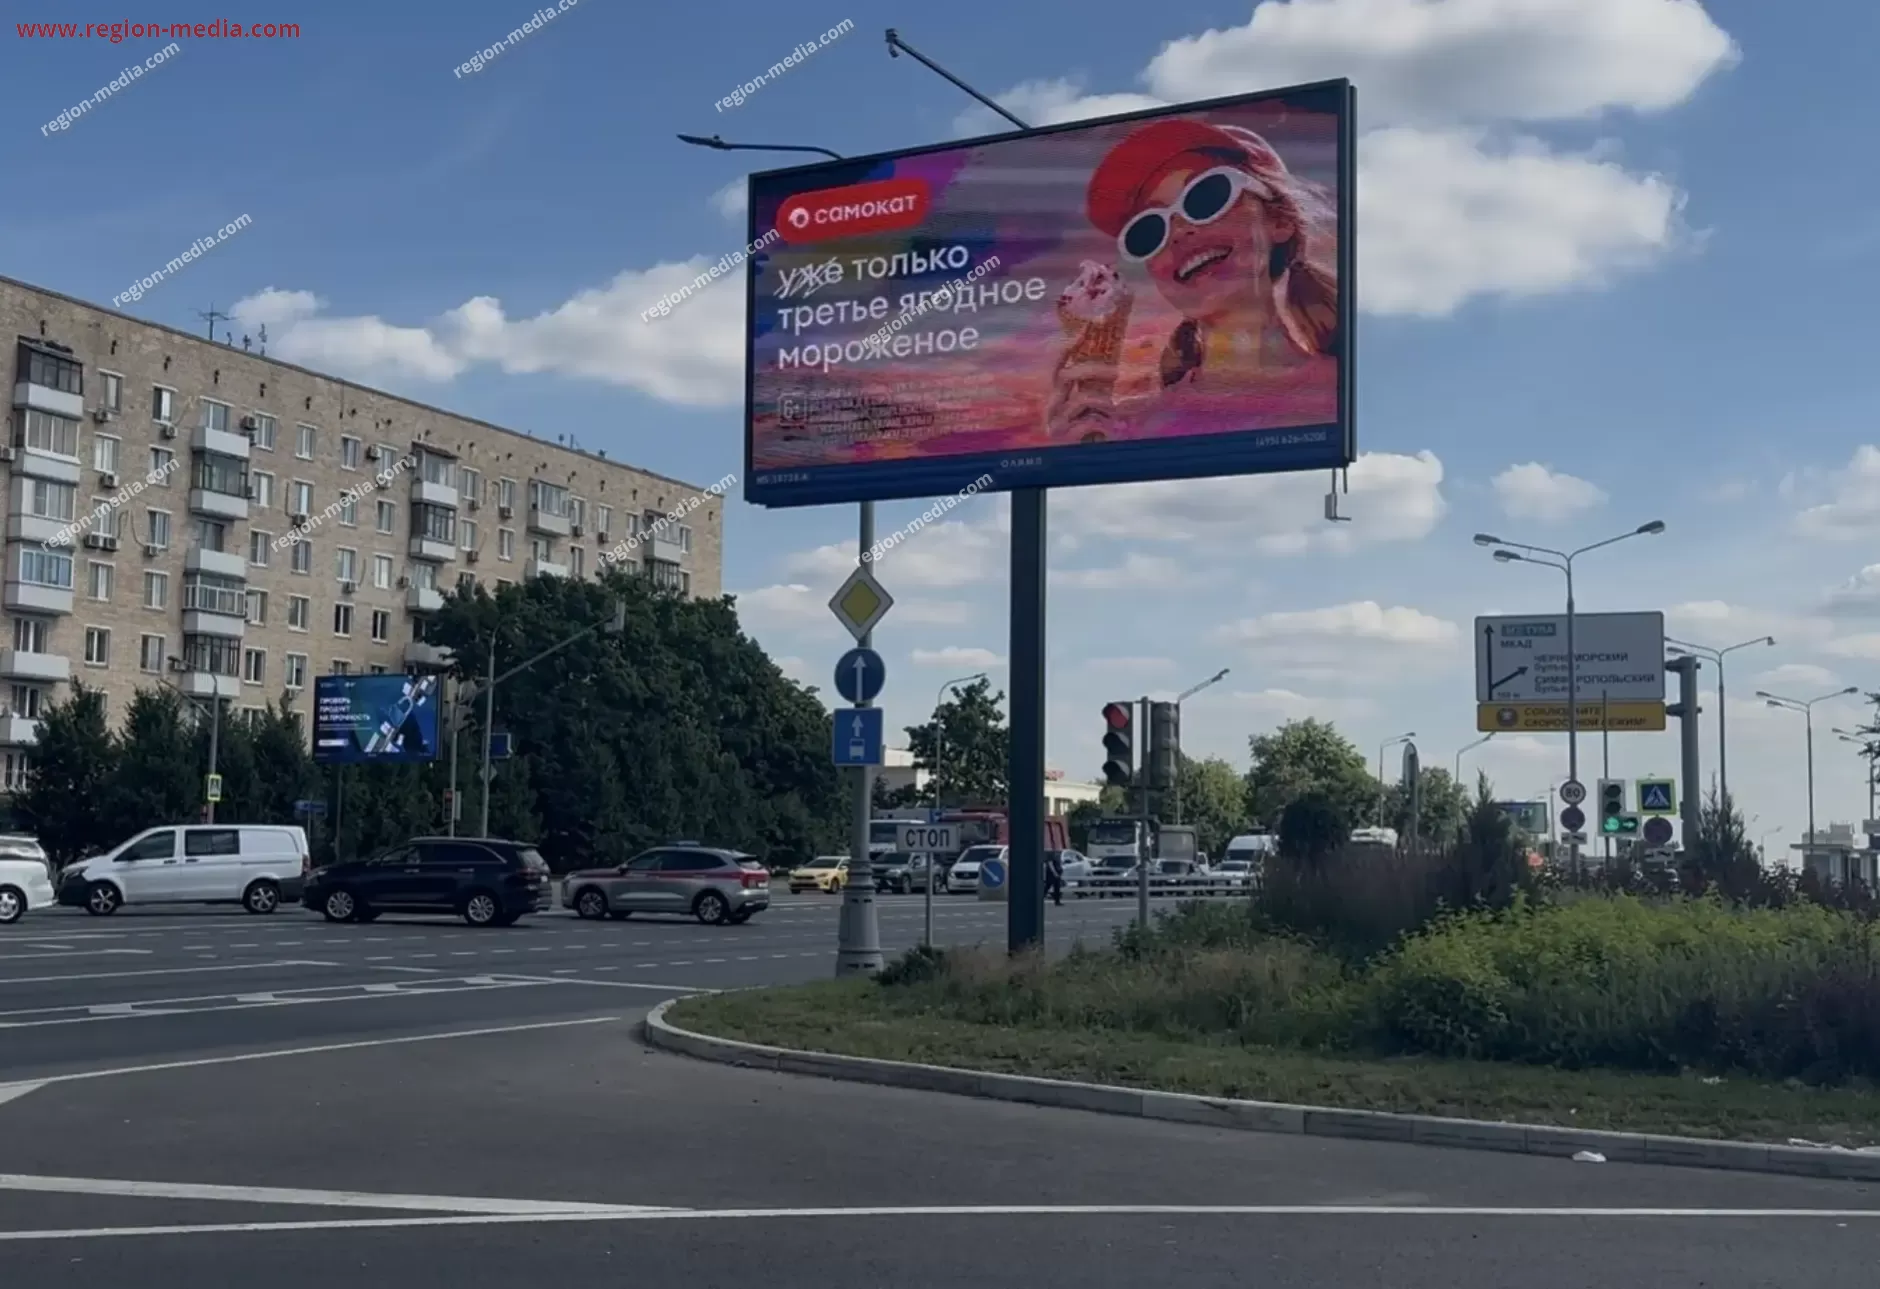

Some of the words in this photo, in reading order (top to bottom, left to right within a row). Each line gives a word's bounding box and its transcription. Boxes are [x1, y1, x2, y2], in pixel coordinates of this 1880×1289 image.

[814, 194, 918, 224] самокат
[852, 245, 969, 281] только
[777, 295, 889, 337] третье
[898, 277, 1047, 315] ягодное
[778, 327, 980, 373] мороженое
[1500, 640, 1532, 650] МКАД
[1534, 652, 1629, 663] ЧЕРНМОРСКИЙ
[1535, 674, 1655, 684] СИМФРОПОЛЬСКИЙ
[1565, 787, 1580, 798] 80
[906, 829, 949, 847] СТОП
